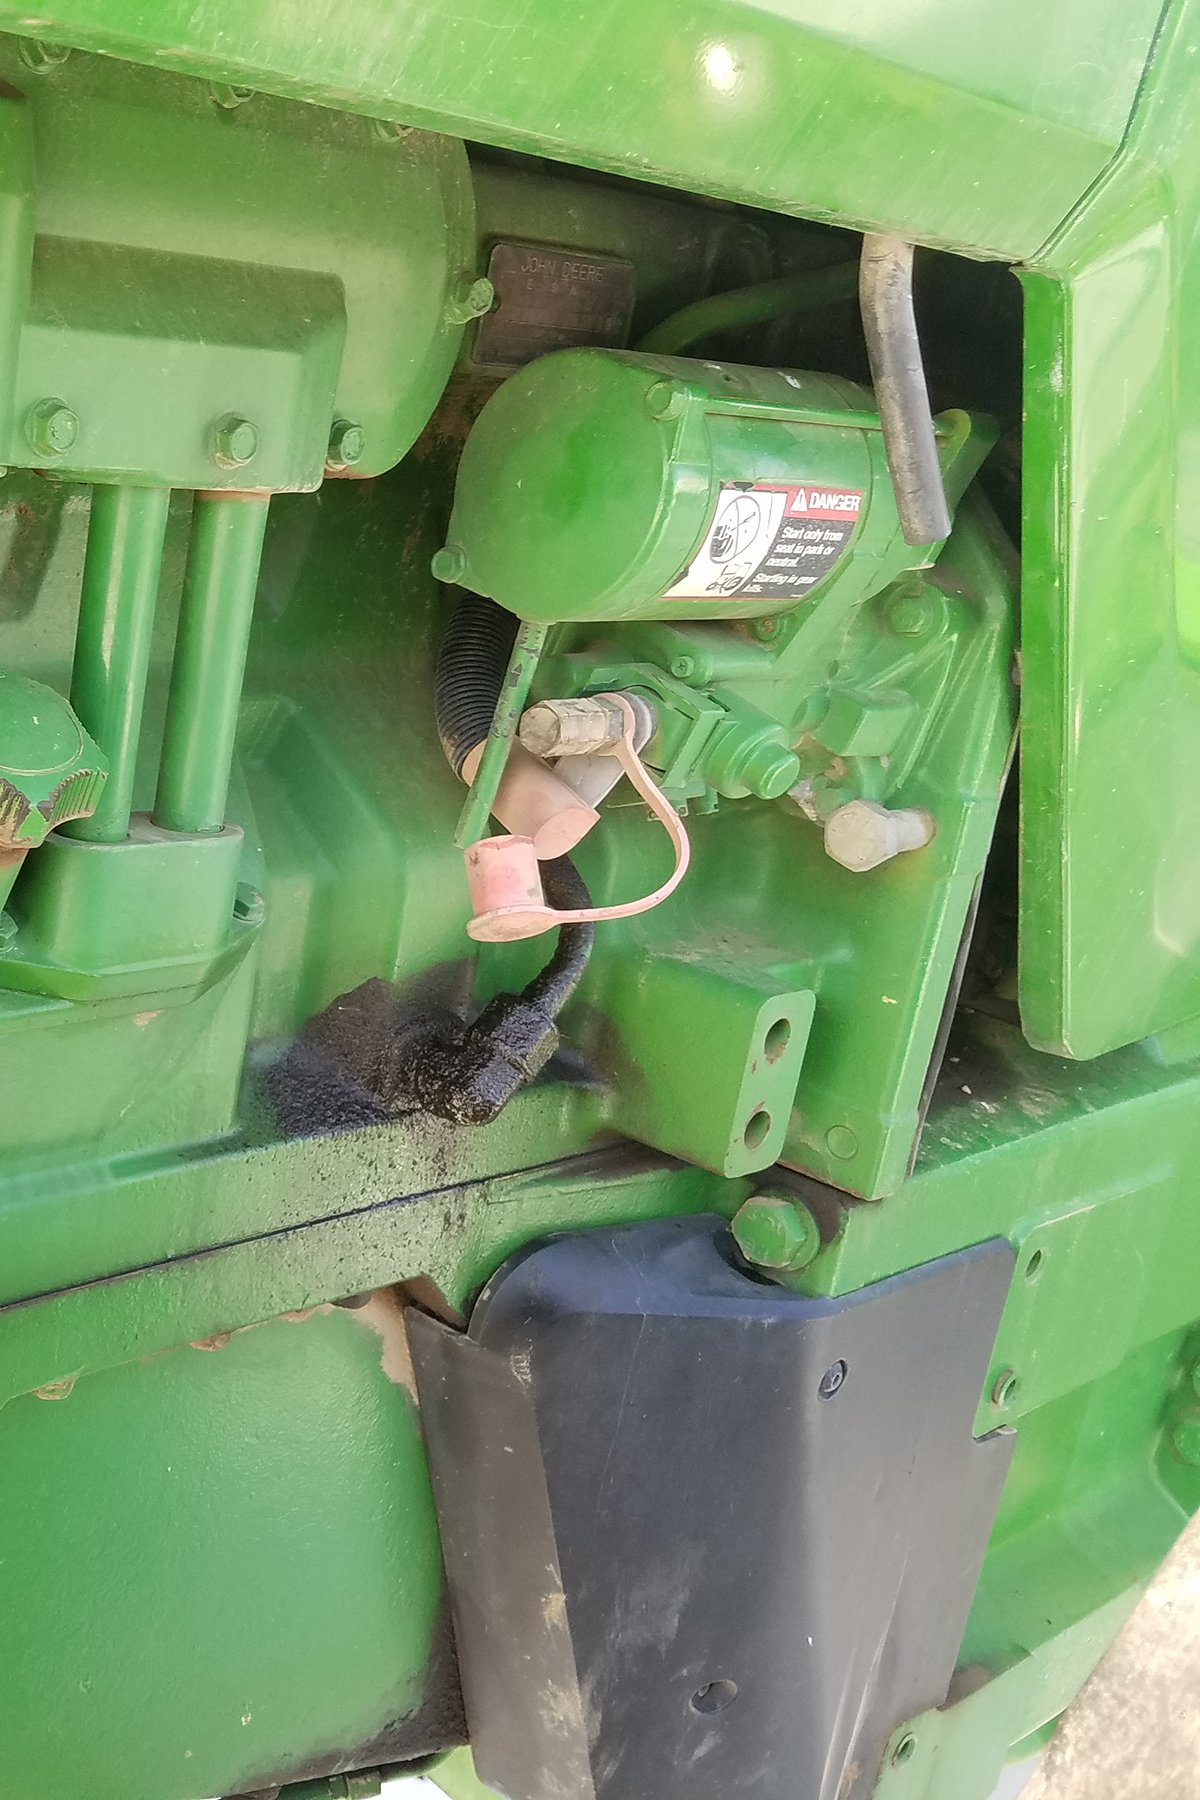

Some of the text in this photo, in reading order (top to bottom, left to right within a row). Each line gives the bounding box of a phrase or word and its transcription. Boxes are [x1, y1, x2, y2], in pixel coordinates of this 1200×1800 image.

[521, 257, 606, 283] JOHN DEERE
[809, 492, 862, 511] DANGER
[782, 527, 844, 543] Start only from
[774, 543, 836, 558] seat in park or
[752, 573, 818, 585] Starting in gear
